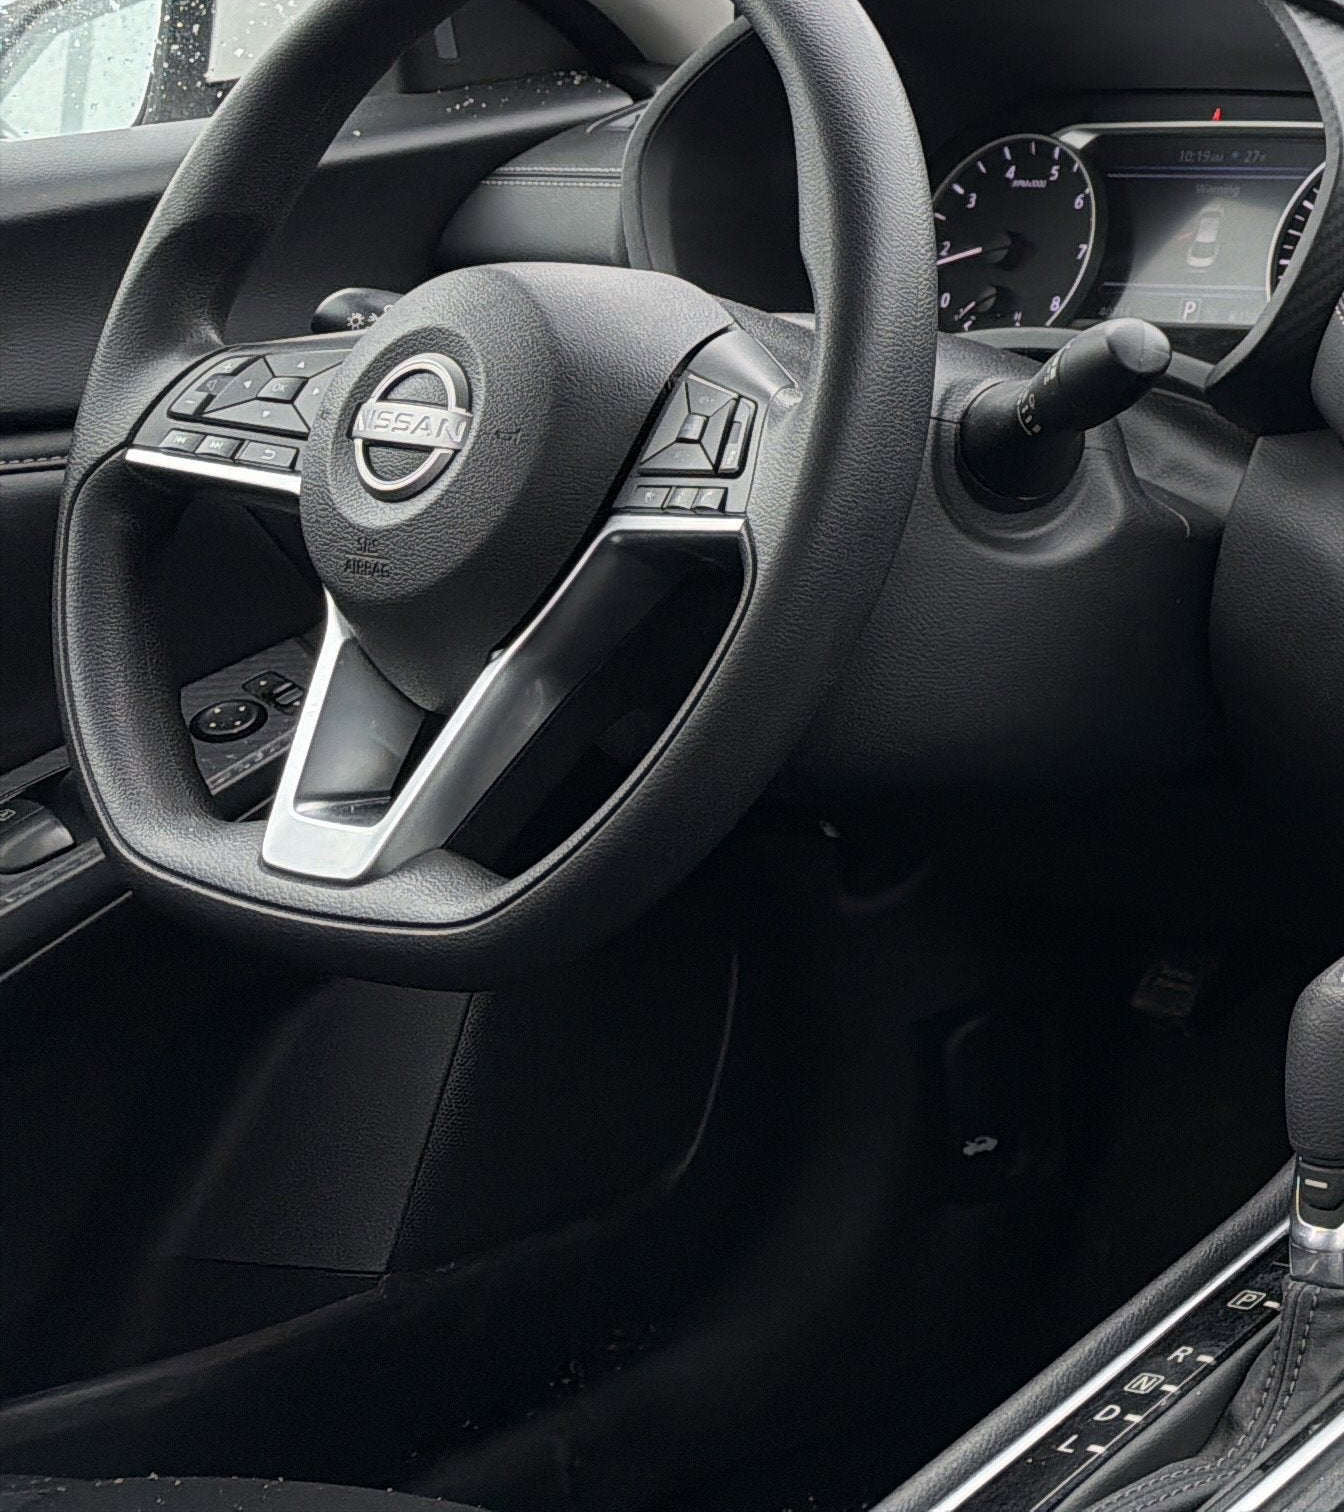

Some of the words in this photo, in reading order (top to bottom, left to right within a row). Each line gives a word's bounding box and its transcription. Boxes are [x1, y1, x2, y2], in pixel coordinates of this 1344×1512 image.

[1004, 164, 1017, 180] 4
[1049, 165, 1060, 181] 5
[965, 192, 977, 209] 3
[1074, 193, 1085, 210] 6
[940, 240, 951, 256] 2
[1076, 243, 1088, 260] 7
[940, 292, 951, 308] 0
[1050, 295, 1061, 311] 8
[1183, 300, 1197, 321] P
[271, 383, 288, 393] OK
[358, 410, 467, 443] NISSAN
[1167, 1346, 1194, 1363] R
[1093, 1404, 1121, 1421] D
[1056, 1434, 1078, 1454] L
